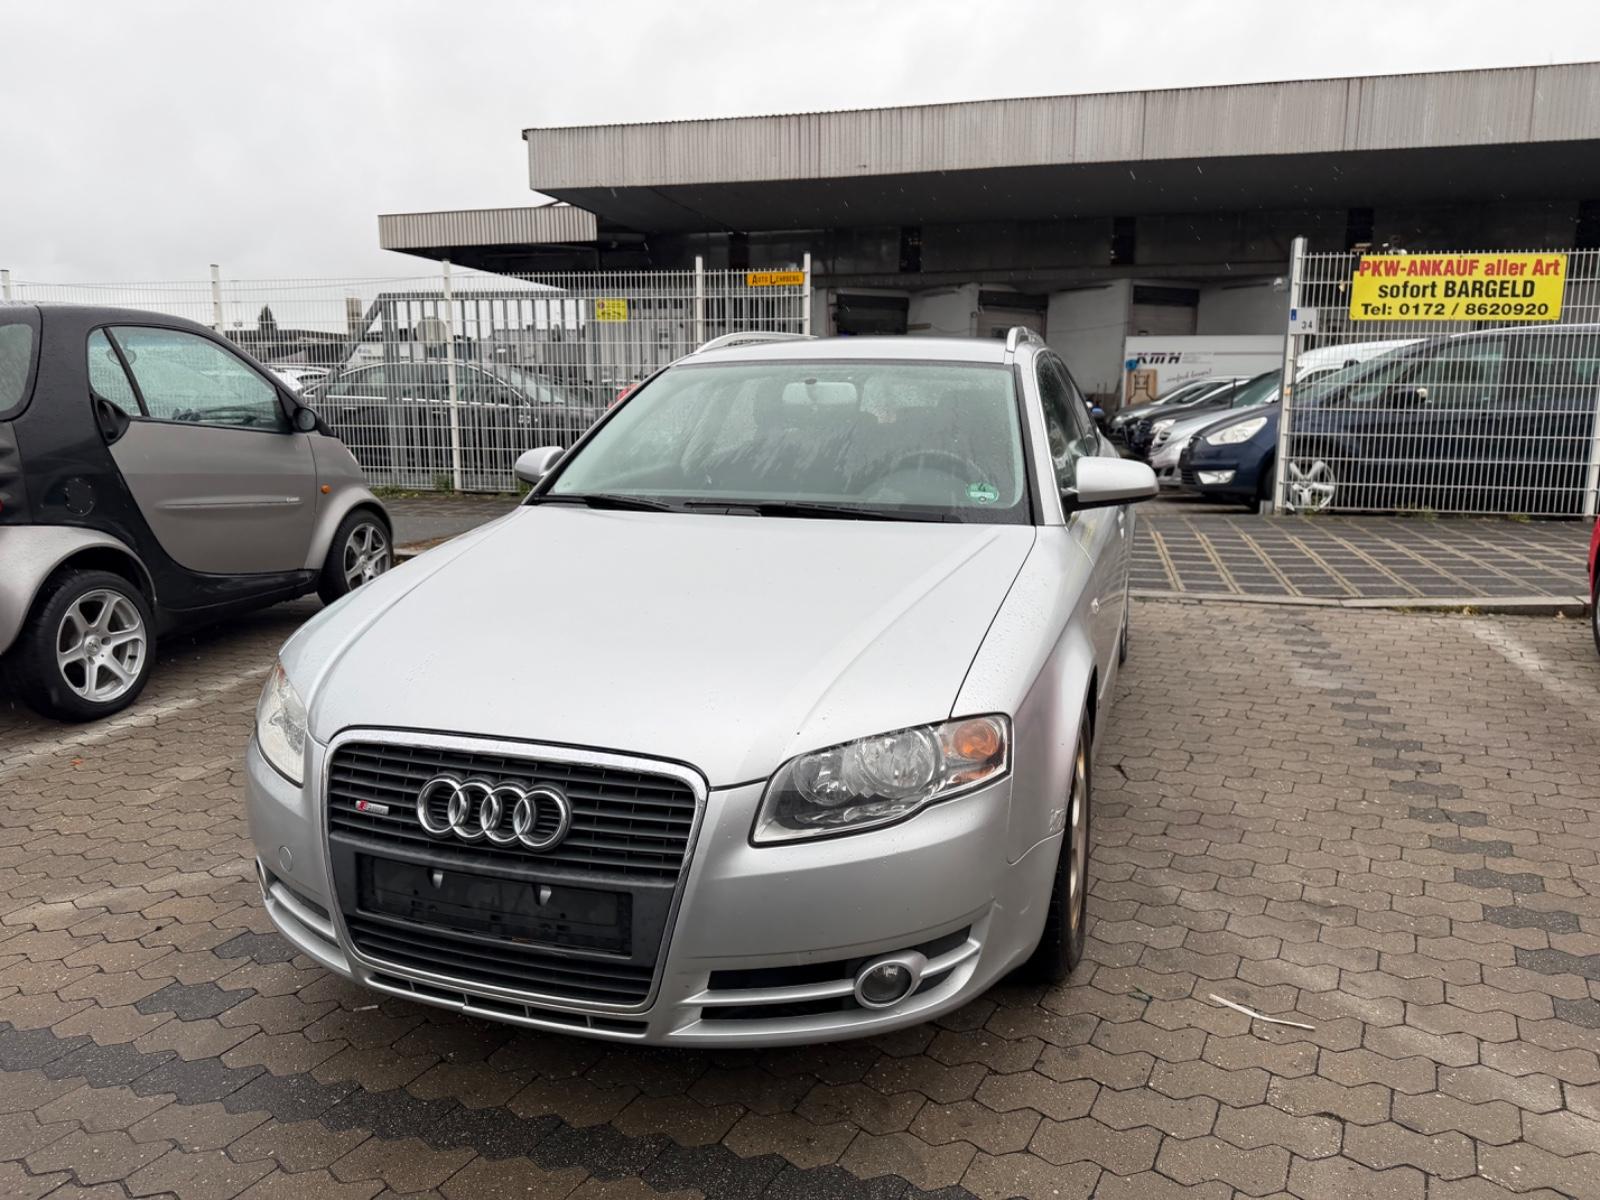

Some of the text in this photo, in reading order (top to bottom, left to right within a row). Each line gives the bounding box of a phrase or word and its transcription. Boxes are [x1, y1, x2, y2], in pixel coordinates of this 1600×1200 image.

[1359, 259, 1560, 277] PKW-ANKAUF aller Art
[1378, 280, 1535, 298] sofort BARGELD
[1361, 303, 1549, 316] Tel: 0172 / 8620920
